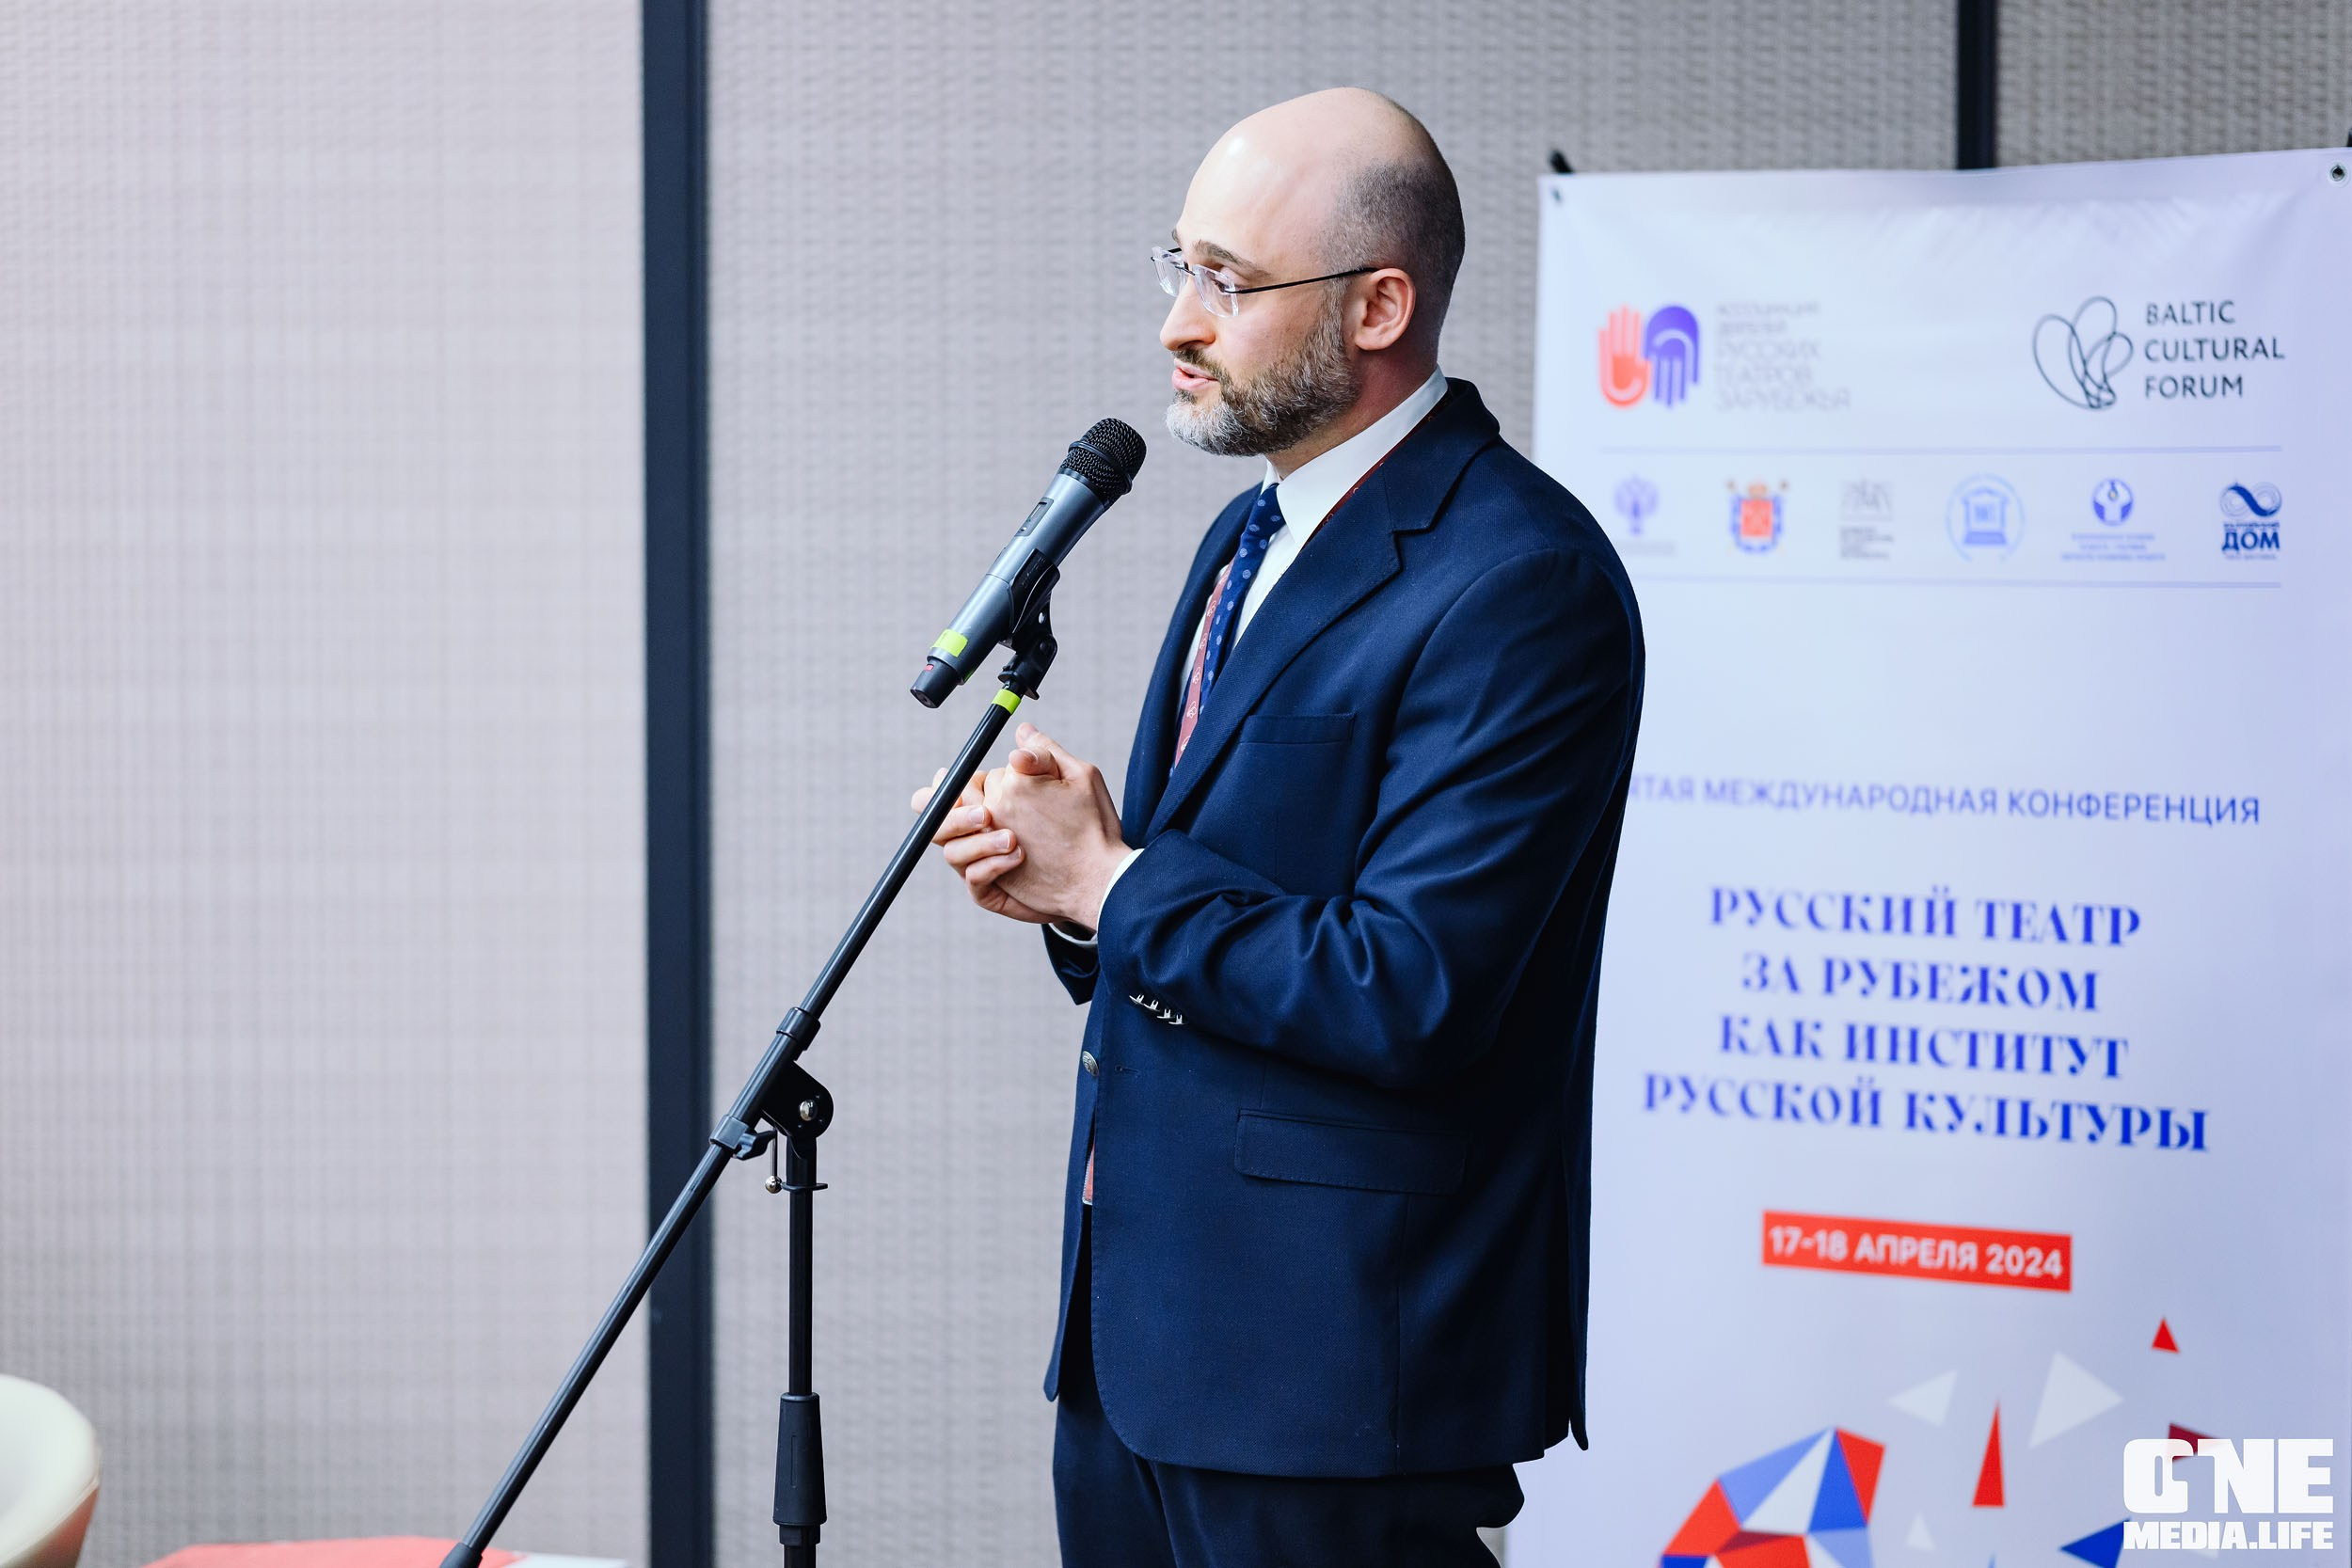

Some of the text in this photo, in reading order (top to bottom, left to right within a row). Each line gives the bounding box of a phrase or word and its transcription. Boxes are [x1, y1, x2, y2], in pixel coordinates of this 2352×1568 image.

[2146, 300, 2236, 325] BALTIC
[2144, 336, 2286, 362] CULTURAL
[2144, 374, 2245, 399] FORUM
[2221, 531, 2280, 551] ДОМ
[1702, 777, 1998, 816] МЕЖДУНАРОДНАЯ
[2007, 788, 2260, 827] КОНФЕРЕНЦИЯ
[1710, 885, 2141, 945] РУССКИЙ ТЕАТР
[1741, 951, 2101, 1011] ЗА РУБЕЖОМ
[1718, 1014, 2129, 1079] КАК ИНСТИТУТ
[1643, 1073, 2209, 1152] РУССКОЙ КУЛЬТУРЫ
[1769, 1225, 2064, 1279] 17-18 АПРЕЛЯ 2024
